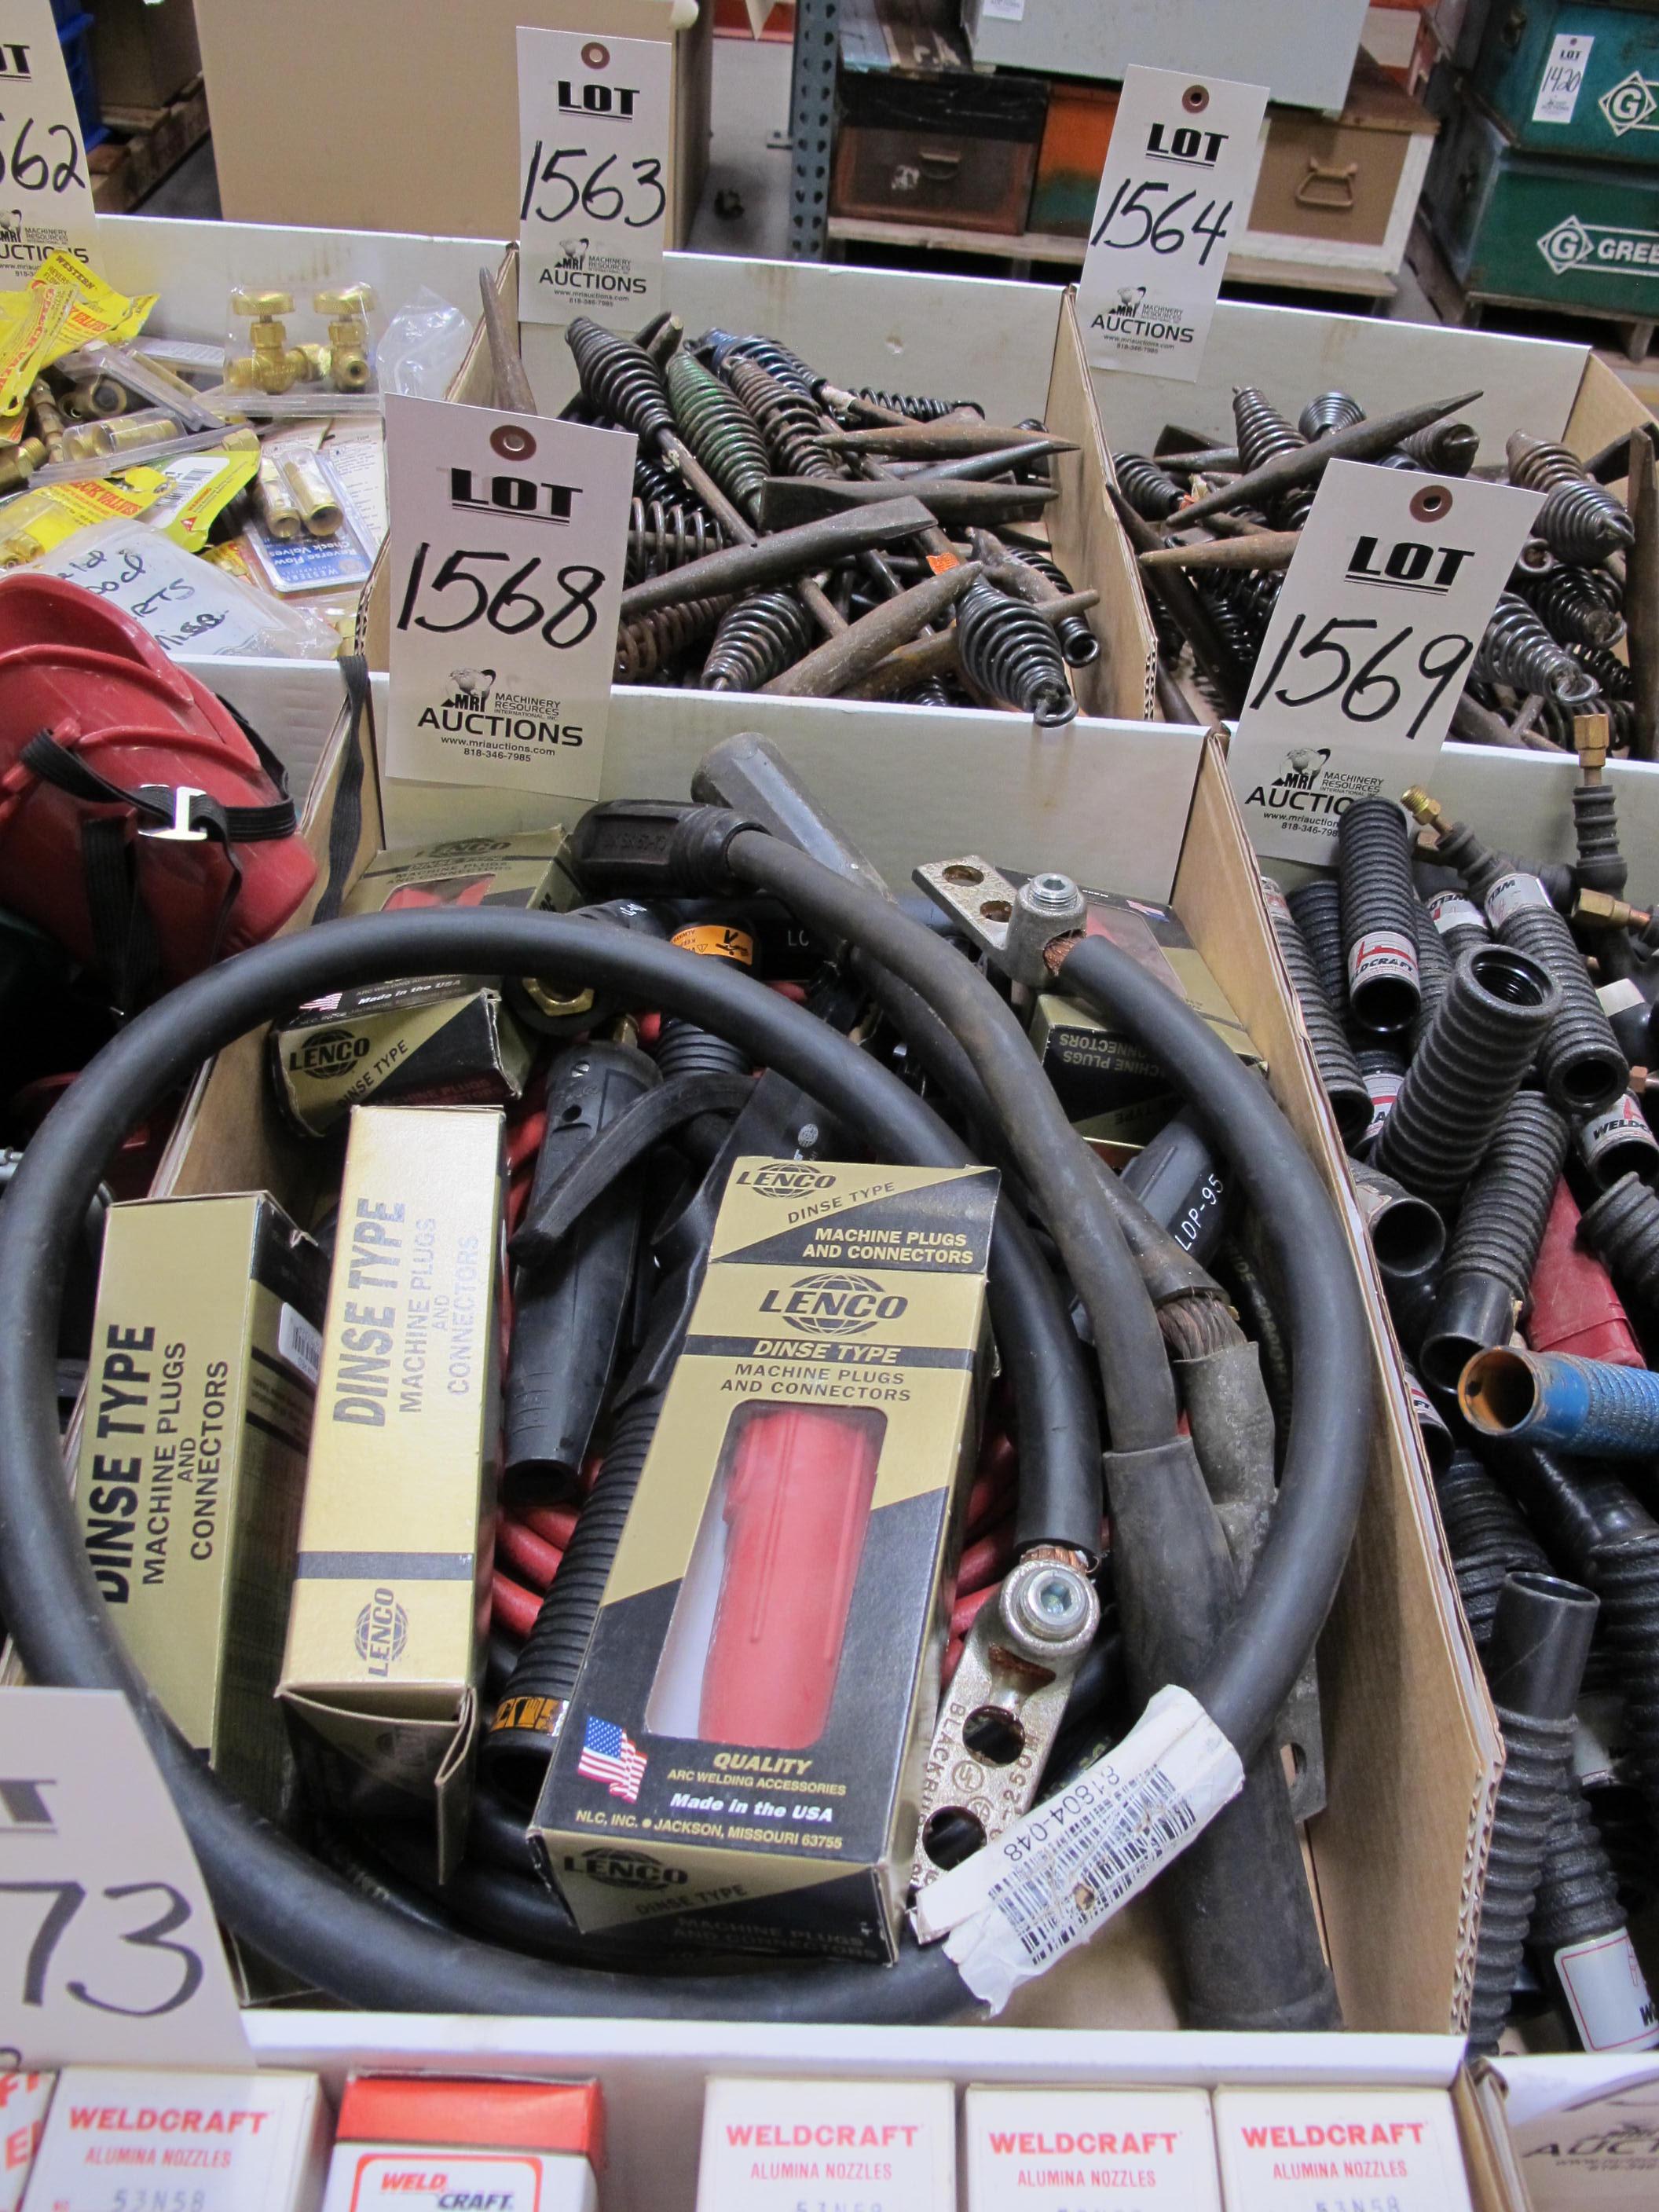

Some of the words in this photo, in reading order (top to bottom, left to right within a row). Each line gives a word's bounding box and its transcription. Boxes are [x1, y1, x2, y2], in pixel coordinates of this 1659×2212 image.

[1560, 49, 1582, 60] LOT
[1542, 66, 1582, 93] 1420
[558, 81, 640, 115] LOT
[0, 112, 86, 192] 62
[1147, 123, 1229, 163] LOT
[521, 140, 666, 228] 1563
[25, 227, 68, 236] MACHINERY
[1090, 178, 1233, 266] 1564
[55, 254, 96, 290] WESTERN
[562, 256, 584, 271] MRI
[589, 255, 632, 265] MACHINERY
[539, 269, 647, 295] AUCTIONS
[1115, 304, 1139, 317] MRI
[1142, 303, 1183, 314] MACHINERY
[1090, 314, 1195, 343] AUCTIONS
[451, 467, 583, 518] LOT
[269, 546, 312, 558] Valves
[307, 548, 358, 561] Reverse
[313, 540, 350, 551] Check
[274, 556, 305, 566] Flow
[1348, 536, 1475, 586] LOT
[397, 542, 606, 650] 1568
[1250, 614, 1474, 740] 1569
[454, 693, 487, 713] MRI
[494, 700, 560, 717] RESOURCES
[495, 692, 562, 709] MACHINERY
[417, 707, 584, 747] AUCTIONS
[441, 736, 555, 756] www.mriauctions.com
[463, 748, 532, 763] 818-346-7985
[1284, 772, 1314, 790] MRI
[1321, 778, 1381, 794] RESOURCES
[1323, 771, 1385, 786] MACHINERY
[1281, 822, 1340, 838] 818-346-798
[357, 992, 393, 1005] Made
[394, 988, 408, 997] in
[410, 983, 432, 994] the
[435, 979, 461, 989] USA
[289, 1038, 371, 1071] LENCO
[373, 1039, 409, 1075] TYPE
[1064, 1050, 1111, 1069] PLUGS
[735, 1170, 837, 1189] LENCO
[787, 1196, 844, 1225] DINSE
[848, 1181, 895, 1204] TYPE
[1174, 1174, 1224, 1251] LDP-95
[347, 1197, 406, 1290] TYPE
[814, 1227, 902, 1245] MACHINE
[905, 1230, 969, 1247] PLUGS
[410, 1218, 436, 1291] PLUGS
[802, 1243, 842, 1258] AND
[847, 1245, 974, 1265] CONNECTORS
[431, 1295, 450, 1332] AND
[446, 1235, 479, 1397] CONNECTORS
[758, 1289, 909, 1320] LENCO
[332, 1301, 396, 1427] DINSE
[399, 1298, 430, 1413] MACHINE
[752, 1339, 836, 1361] DINSE
[838, 1344, 902, 1364] TYPE
[96, 1324, 156, 1438] TYPE
[734, 1363, 831, 1381] MACHINE
[837, 1369, 906, 1386] PLUGS
[156, 1342, 186, 1434] PLUGS
[720, 1379, 763, 1393] AND
[770, 1382, 911, 1402] CONNECTORS
[177, 1437, 197, 1483] AND
[190, 1360, 229, 1561] CONNECTORS
[142, 1445, 177, 1585] MACHINE
[368, 1587, 394, 1678] LENCO
[712, 1752, 814, 1776] QUALITY
[667, 1769, 695, 1782] ARC
[697, 1771, 754, 1788] WELDING
[756, 1777, 848, 1797] ACCESSORIES
[669, 1793, 725, 1811] Made
[727, 1798, 749, 1815] in
[753, 1801, 788, 1818] the
[791, 1804, 833, 1822] USA
[576, 1809, 607, 1826] NLC,
[610, 1813, 639, 1829] INC.
[654, 1818, 725, 1839] JACKSON,
[727, 1826, 799, 1845] MISSOURI
[801, 1835, 844, 1850] 63755
[564, 1855, 689, 1885] LENCO
[635, 1895, 694, 1916] DINSE
[696, 1884, 749, 1906] TYPE
[68, 2106, 269, 2135] WELDCRAFT
[726, 2125, 919, 2148] WELDCRAFT
[988, 2131, 1178, 2155] WELDCRAFT
[1241, 2122, 1425, 2149] WELDCRAFT
[84, 2146, 157, 2166] ALUMINA
[162, 2149, 232, 2169] NOZZLES
[1273, 2160, 1340, 2181] ALUMINA
[1343, 2159, 1409, 2179] NOZZLES
[380, 2172, 449, 2191] WELD
[750, 2162, 819, 2181] ALUMINA
[826, 2163, 892, 2181] NOZZLES
[1017, 2169, 1086, 2188] ALUMINA
[1090, 2170, 1157, 2188] NOZZLES
[438, 2193, 514, 2210] CRAFT
